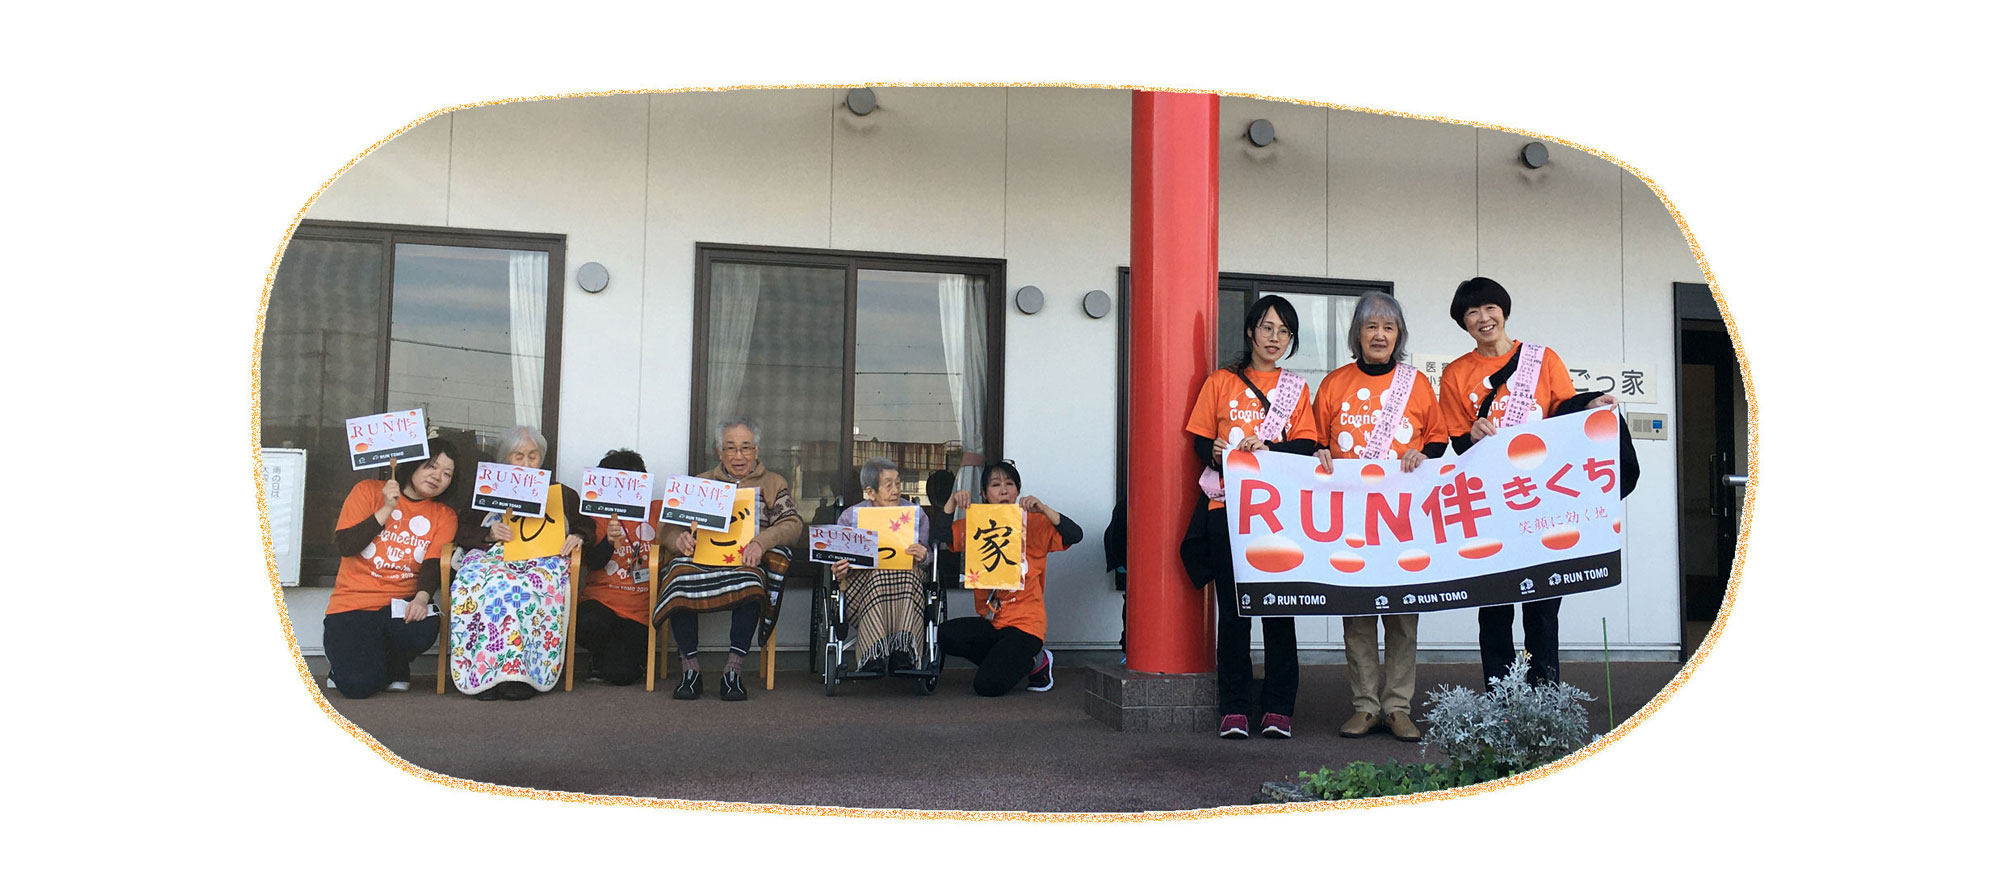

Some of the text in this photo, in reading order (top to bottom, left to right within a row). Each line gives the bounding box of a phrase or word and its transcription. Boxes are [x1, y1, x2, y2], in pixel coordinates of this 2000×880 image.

[1238, 458, 1616, 545] RUN伴 きくち
[1520, 506, 1608, 535] 笑顔に効く地
[973, 518, 1018, 573] 家
[1563, 567, 1609, 584] RUN TOMO
[1277, 595, 1327, 605] RUN TOMO
[1417, 590, 1468, 604] RUN TOMO
